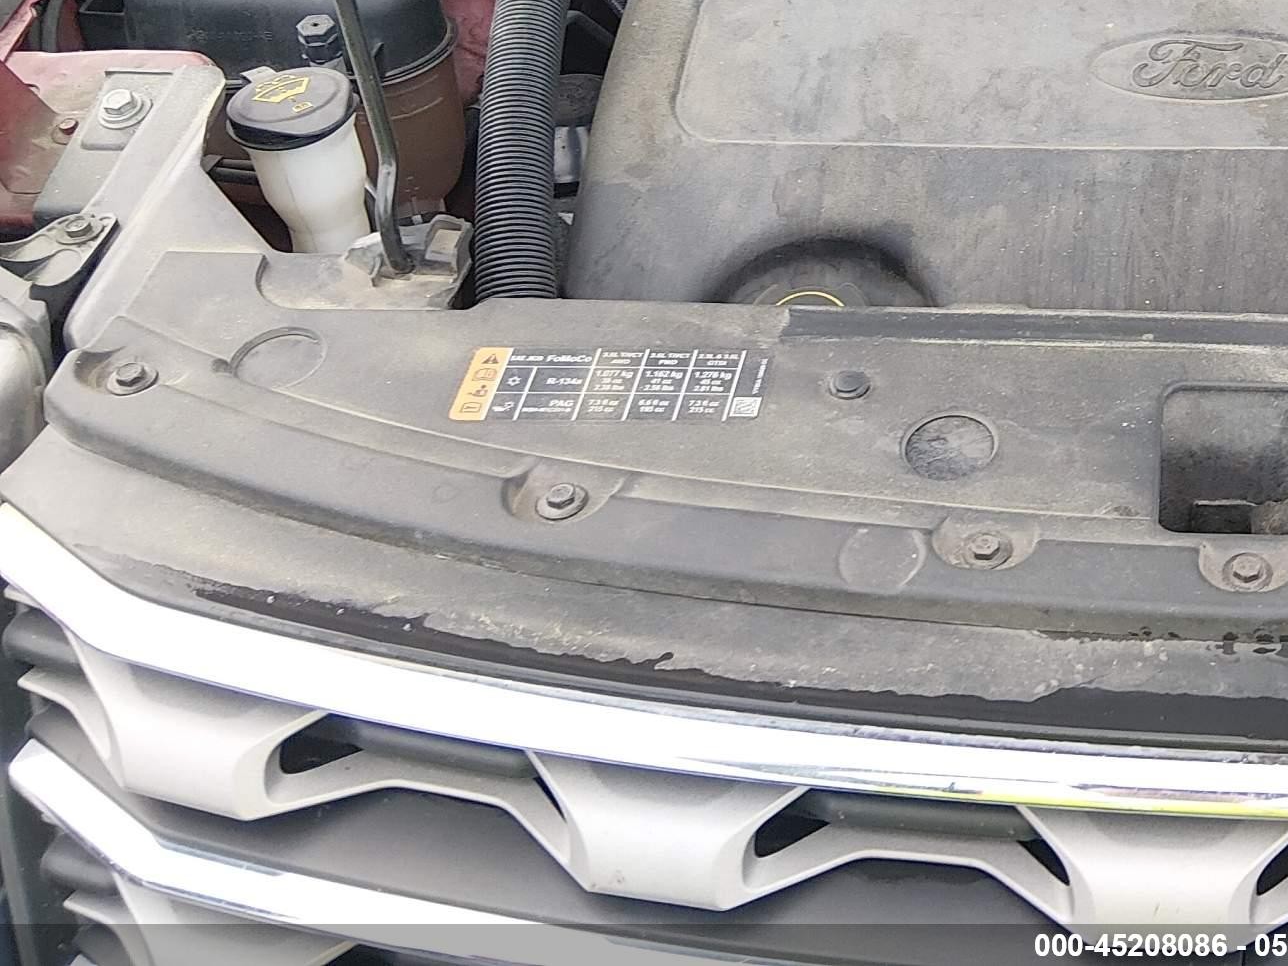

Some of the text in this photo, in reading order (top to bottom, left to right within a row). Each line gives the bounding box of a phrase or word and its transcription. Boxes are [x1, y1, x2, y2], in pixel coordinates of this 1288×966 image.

[1132, 39, 1288, 88] Ford
[545, 354, 593, 363] FoMoCo
[545, 377, 583, 385] R-134a
[548, 399, 575, 407] PAG
